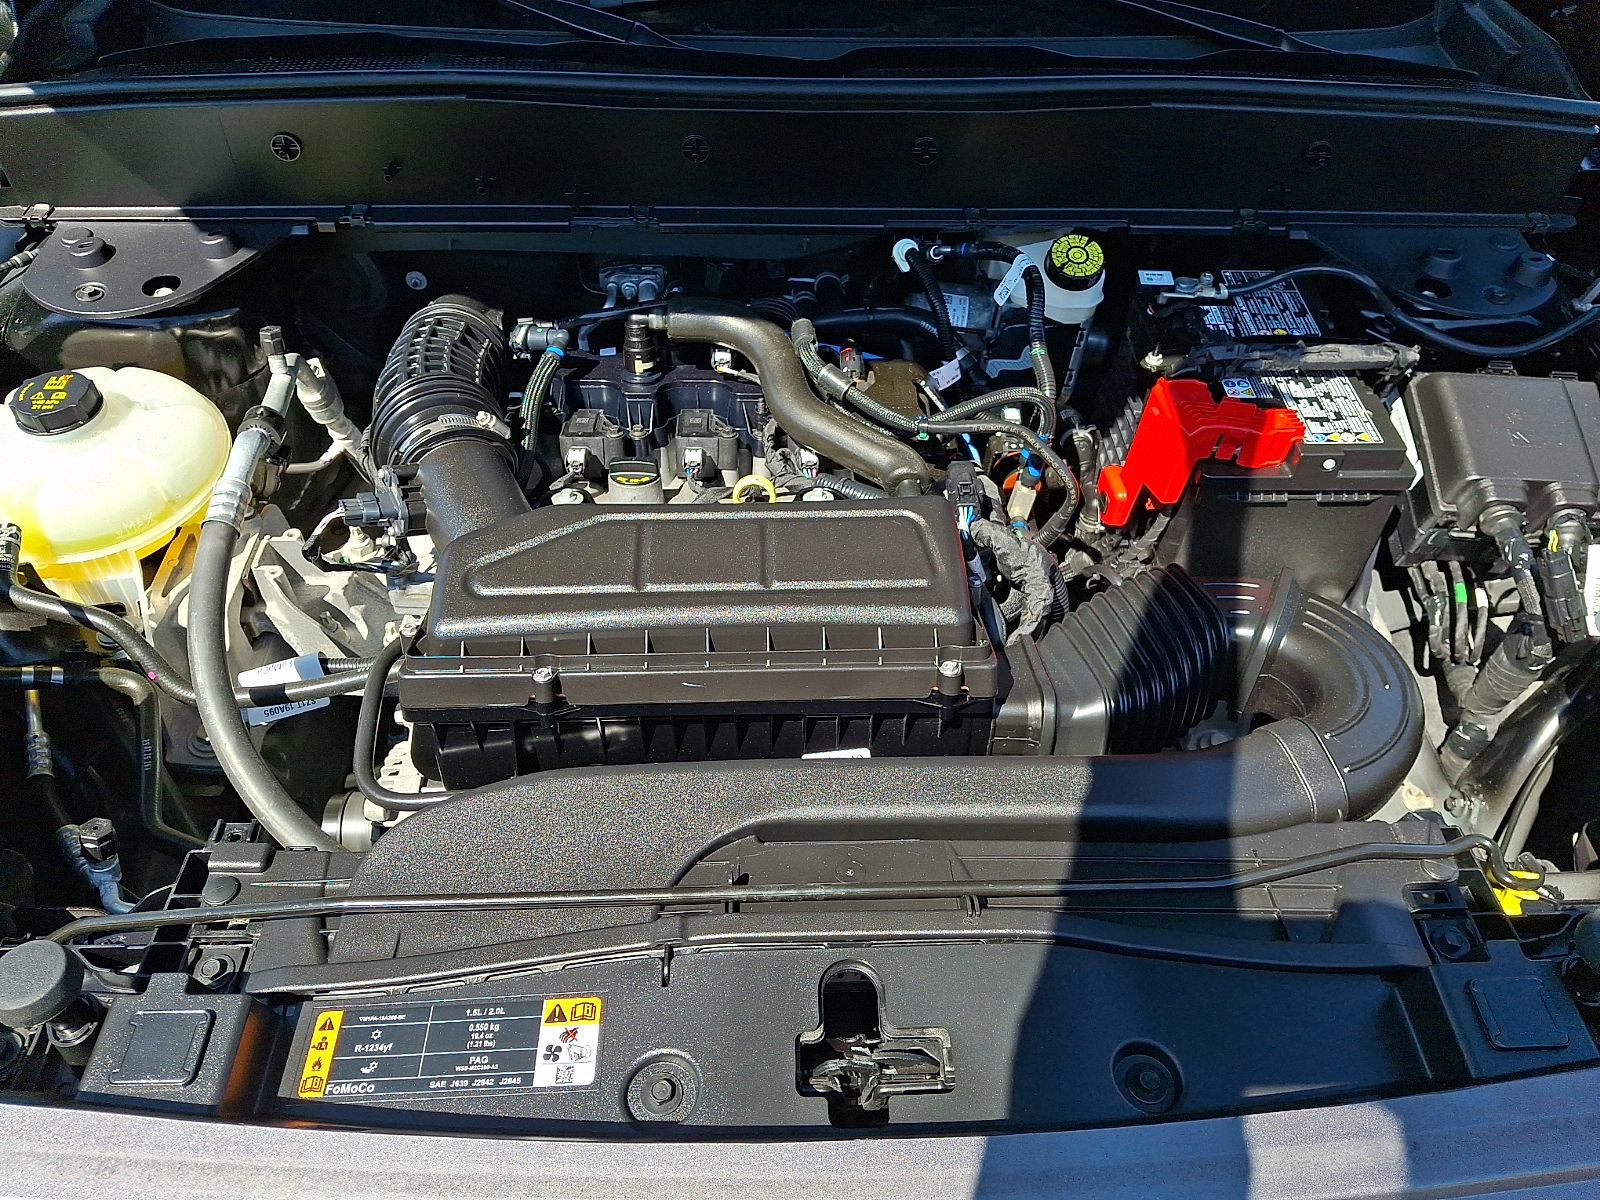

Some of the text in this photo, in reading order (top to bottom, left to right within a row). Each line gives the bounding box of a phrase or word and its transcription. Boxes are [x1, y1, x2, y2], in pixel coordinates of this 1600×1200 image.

[263, 703, 294, 718] 19A095
[488, 1007, 506, 1015] 2.0L
[468, 1022, 500, 1032] 0.550 kg
[354, 1042, 394, 1054] R-1234yf
[469, 1055, 489, 1065] PAG
[429, 1077, 521, 1088] SAE J639 J2842 J2845
[324, 1082, 375, 1095] FoMoCo
